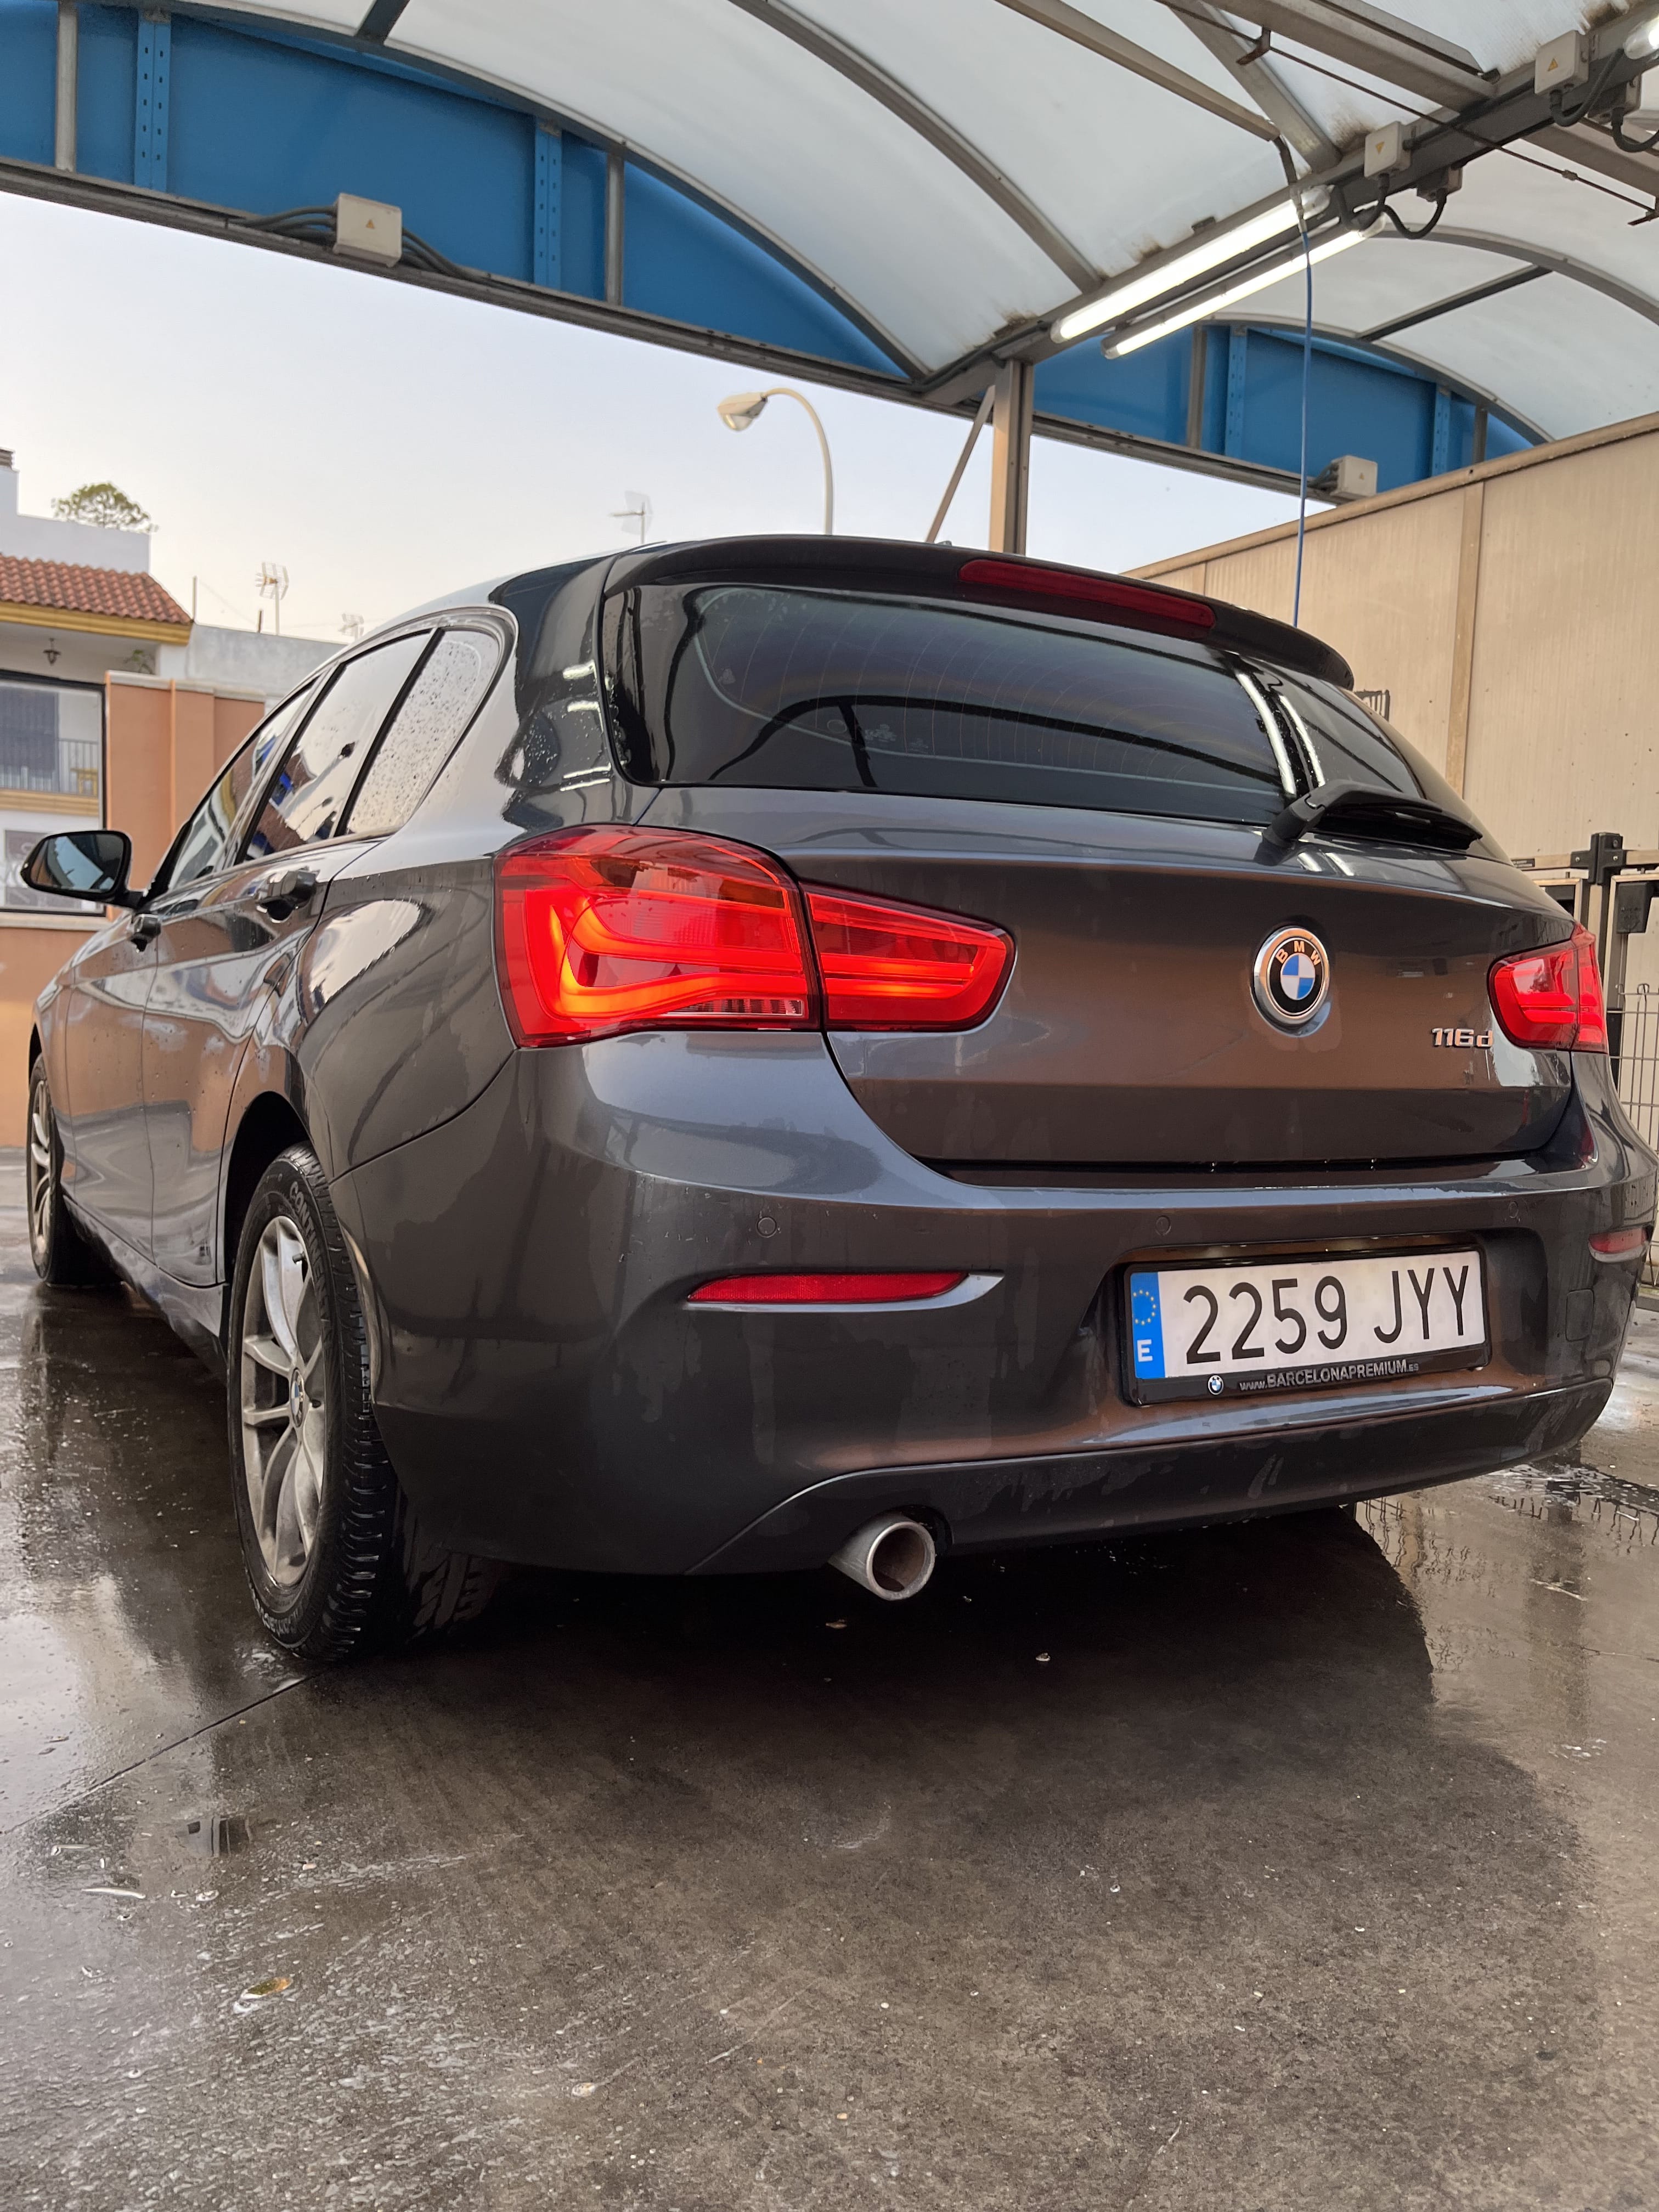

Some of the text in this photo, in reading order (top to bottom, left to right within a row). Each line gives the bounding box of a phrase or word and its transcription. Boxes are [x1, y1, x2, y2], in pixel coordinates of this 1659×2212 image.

[1276, 940, 1321, 966] BMW
[1432, 1028, 1493, 1047] 116d
[1183, 1265, 1470, 1365] 2259 JYY
[1137, 1339, 1153, 1362] E
